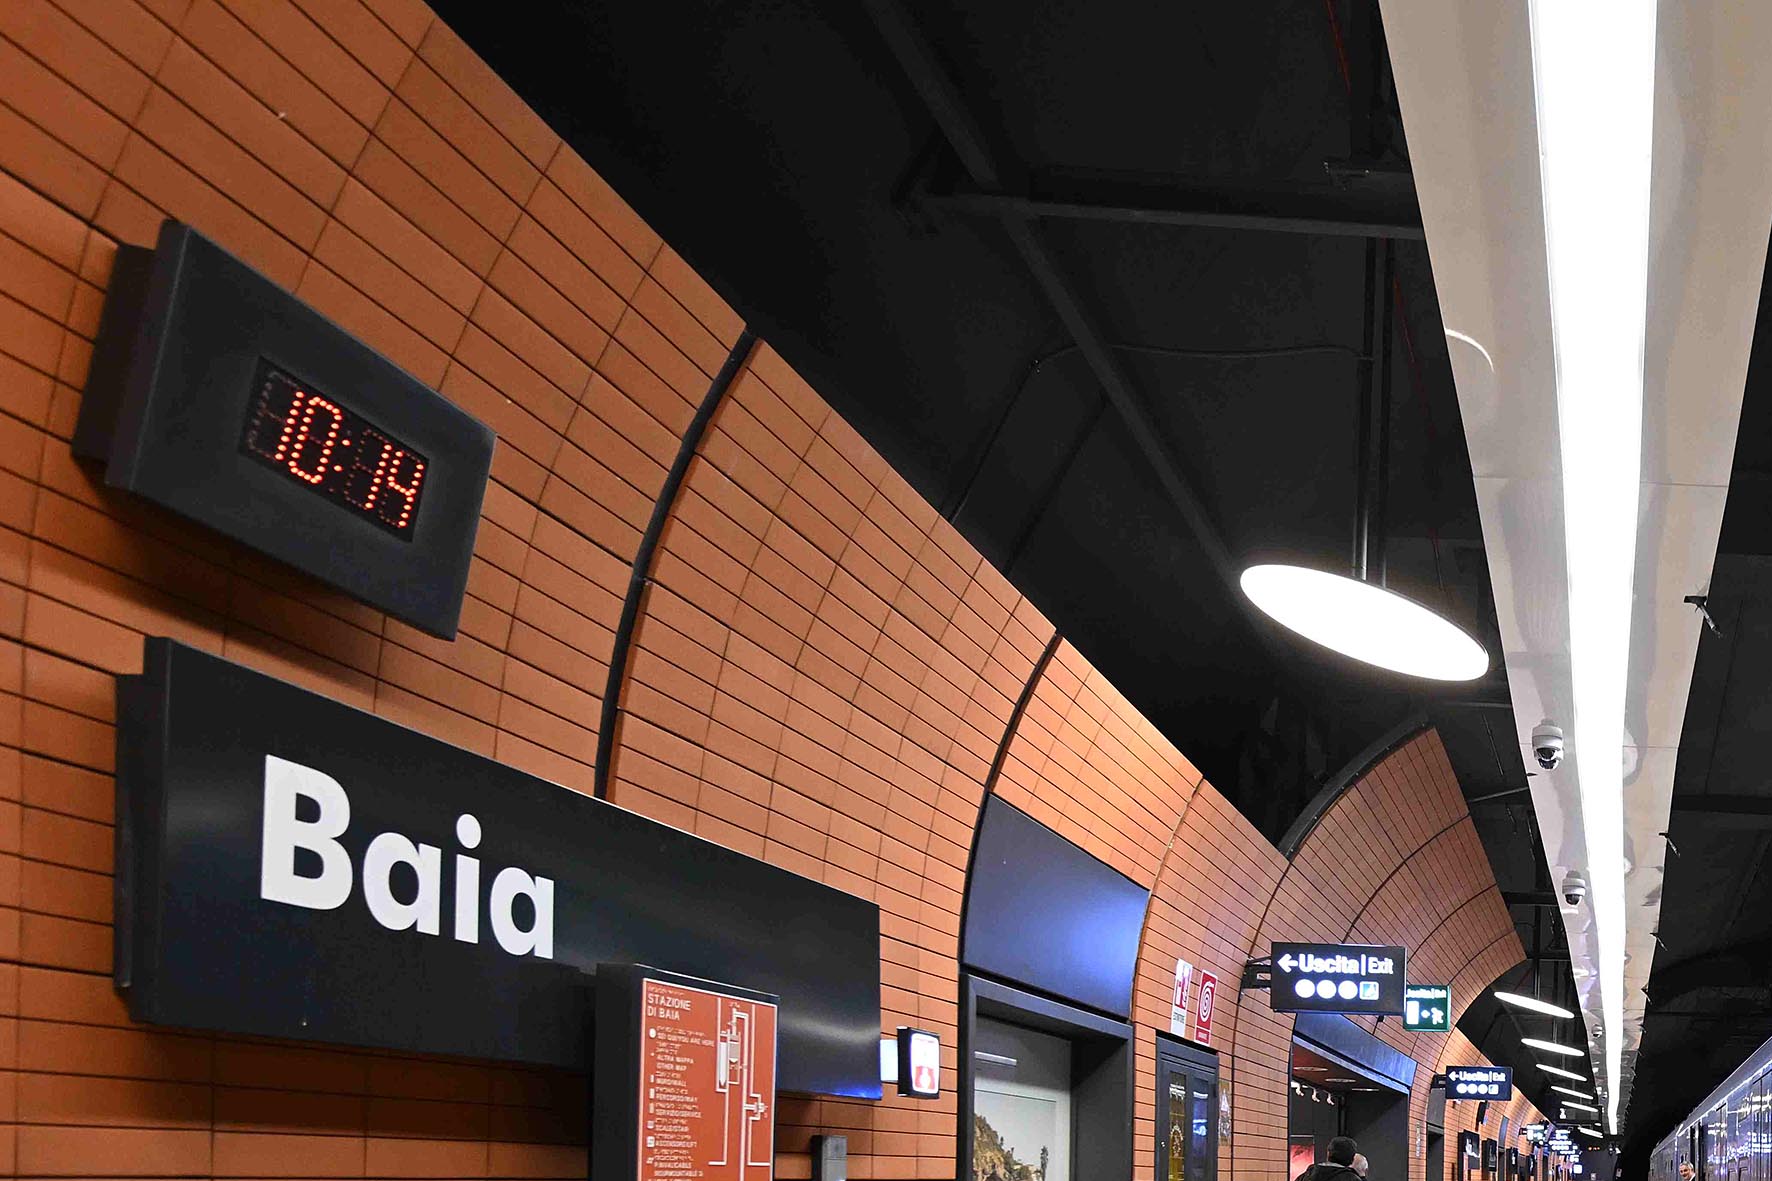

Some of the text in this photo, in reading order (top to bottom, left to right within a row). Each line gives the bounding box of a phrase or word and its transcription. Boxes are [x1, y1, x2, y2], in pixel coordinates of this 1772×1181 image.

[275, 391, 424, 527] 10:14
[260, 755, 554, 960] Baia
[1299, 954, 1393, 974] Uscita Exit
[647, 993, 691, 1011] STAZIONE
[647, 1006, 680, 1020] DI BAIA
